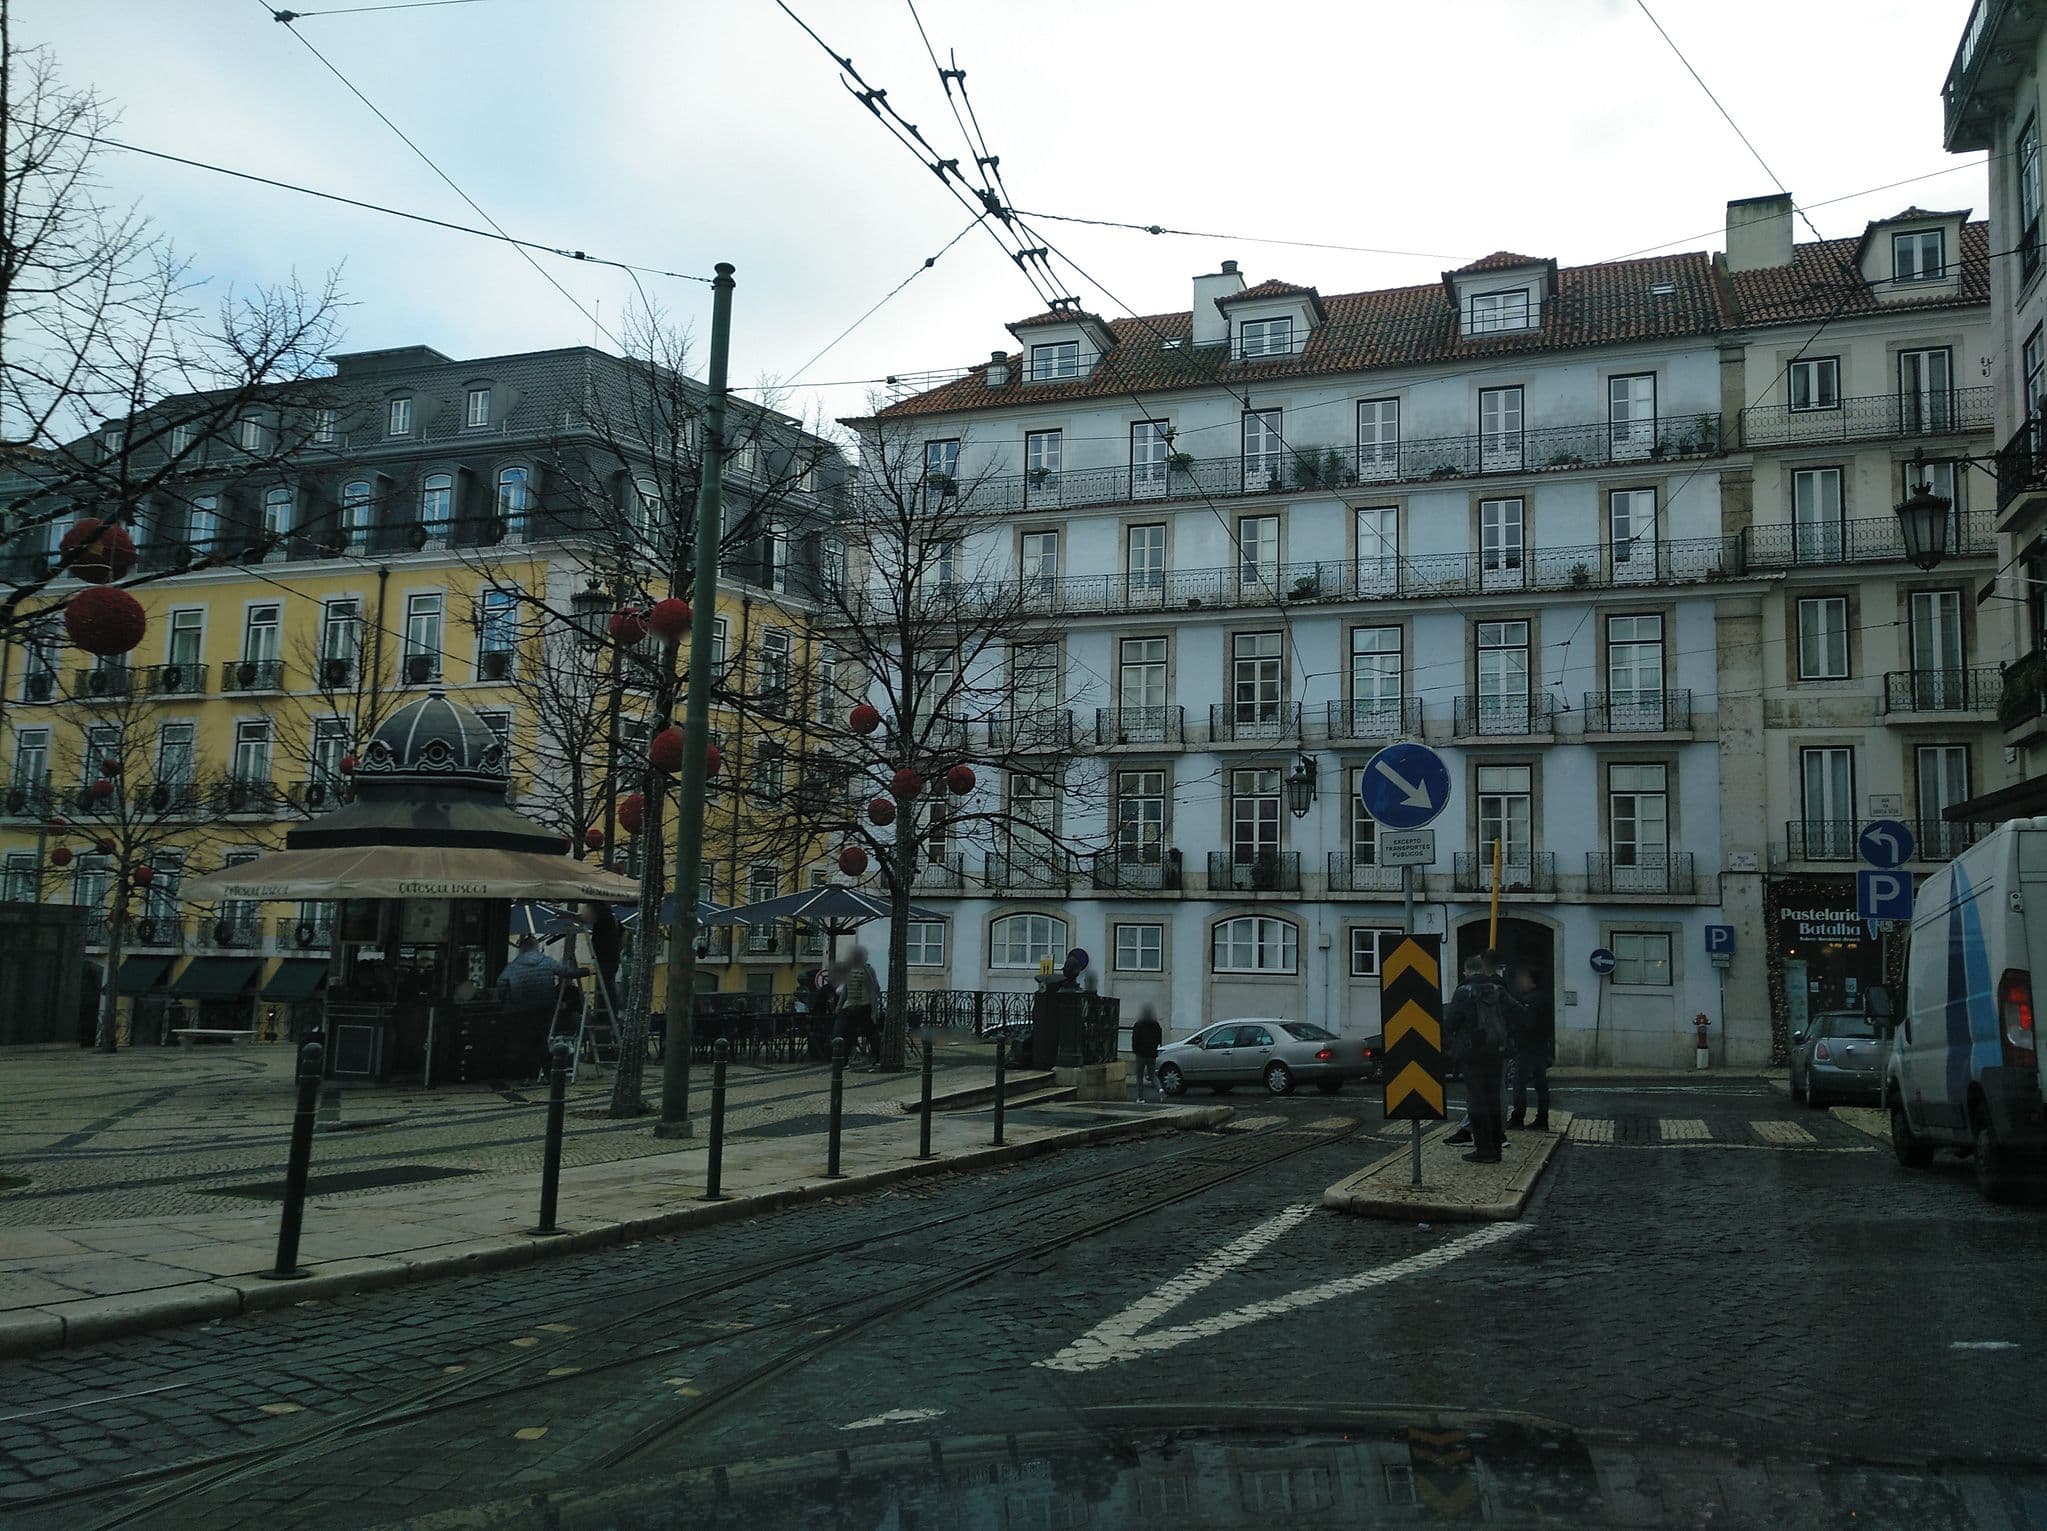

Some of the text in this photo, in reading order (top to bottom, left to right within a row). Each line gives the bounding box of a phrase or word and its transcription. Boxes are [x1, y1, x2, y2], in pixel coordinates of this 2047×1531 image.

[1869, 874, 1900, 914] P
[1781, 908, 1861, 921] Pastelaria
[1799, 922, 1861, 936] Batalha
[1711, 928, 1728, 950] P
